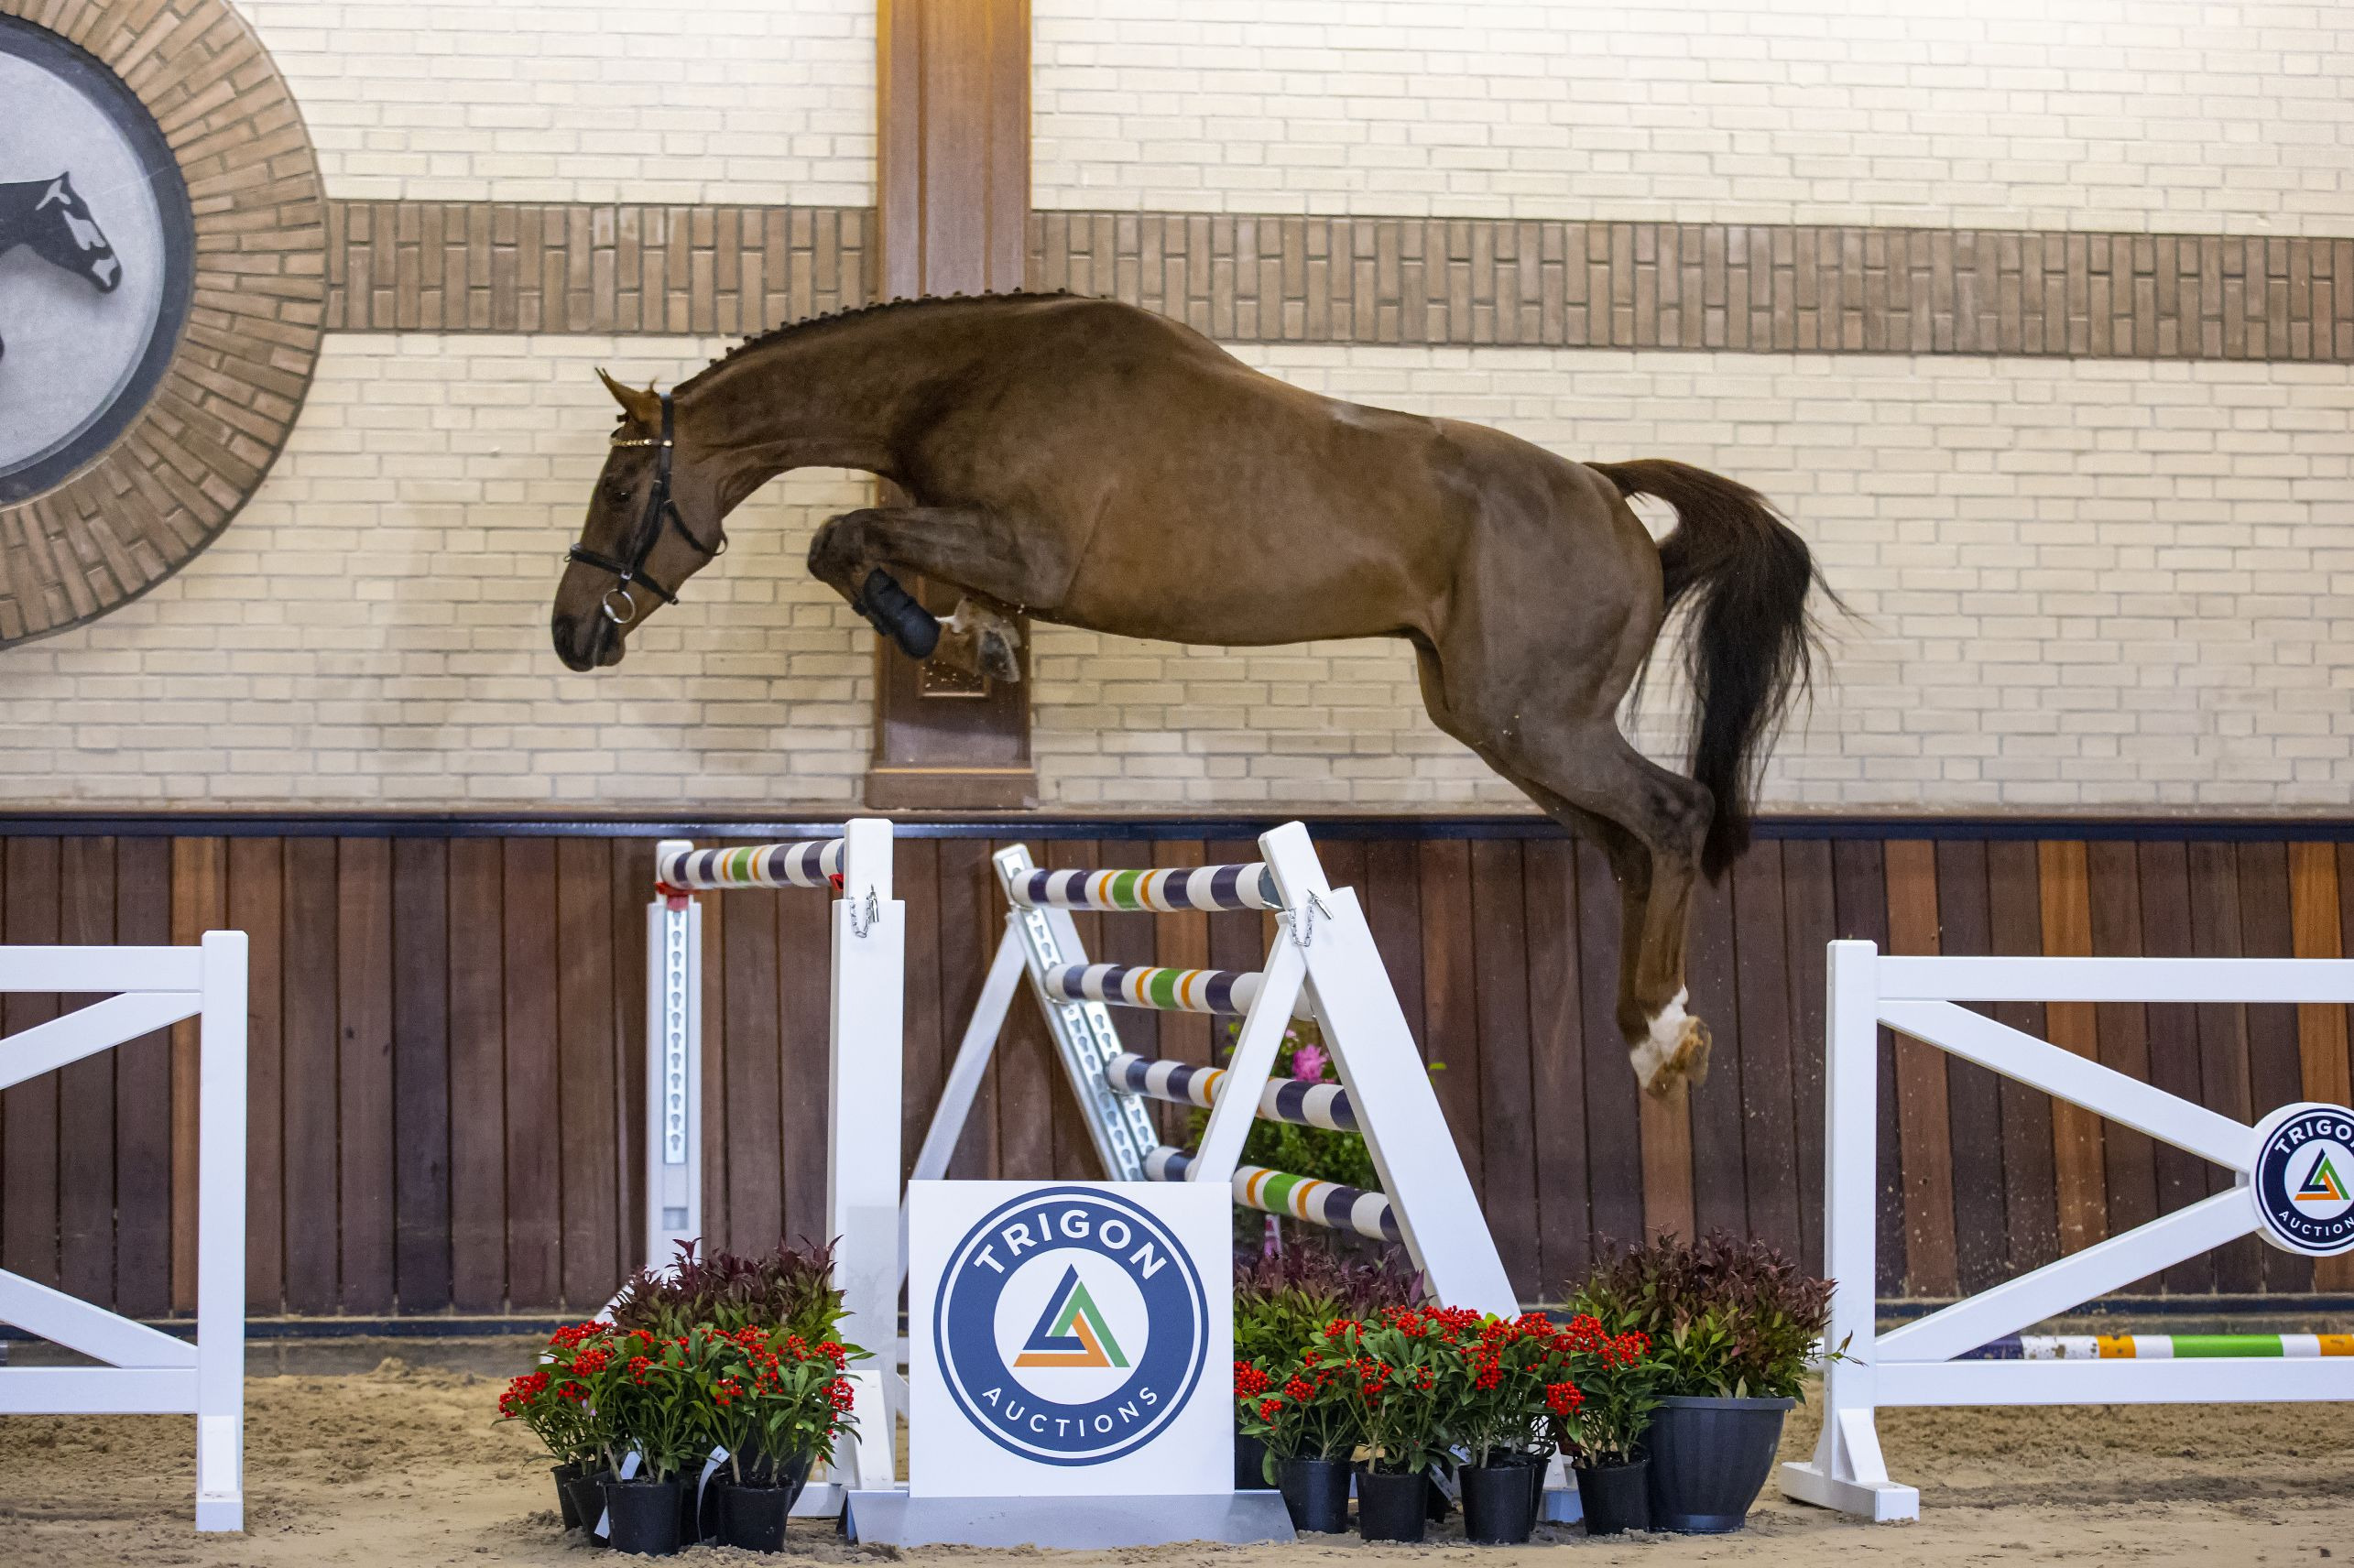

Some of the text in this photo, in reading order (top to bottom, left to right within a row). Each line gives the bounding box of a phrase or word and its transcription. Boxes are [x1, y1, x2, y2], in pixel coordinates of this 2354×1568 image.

[2274, 1119, 2354, 1154] TRIGO
[974, 1209, 1167, 1280] TRIGON
[982, 1387, 1158, 1437] AUCTIONS
